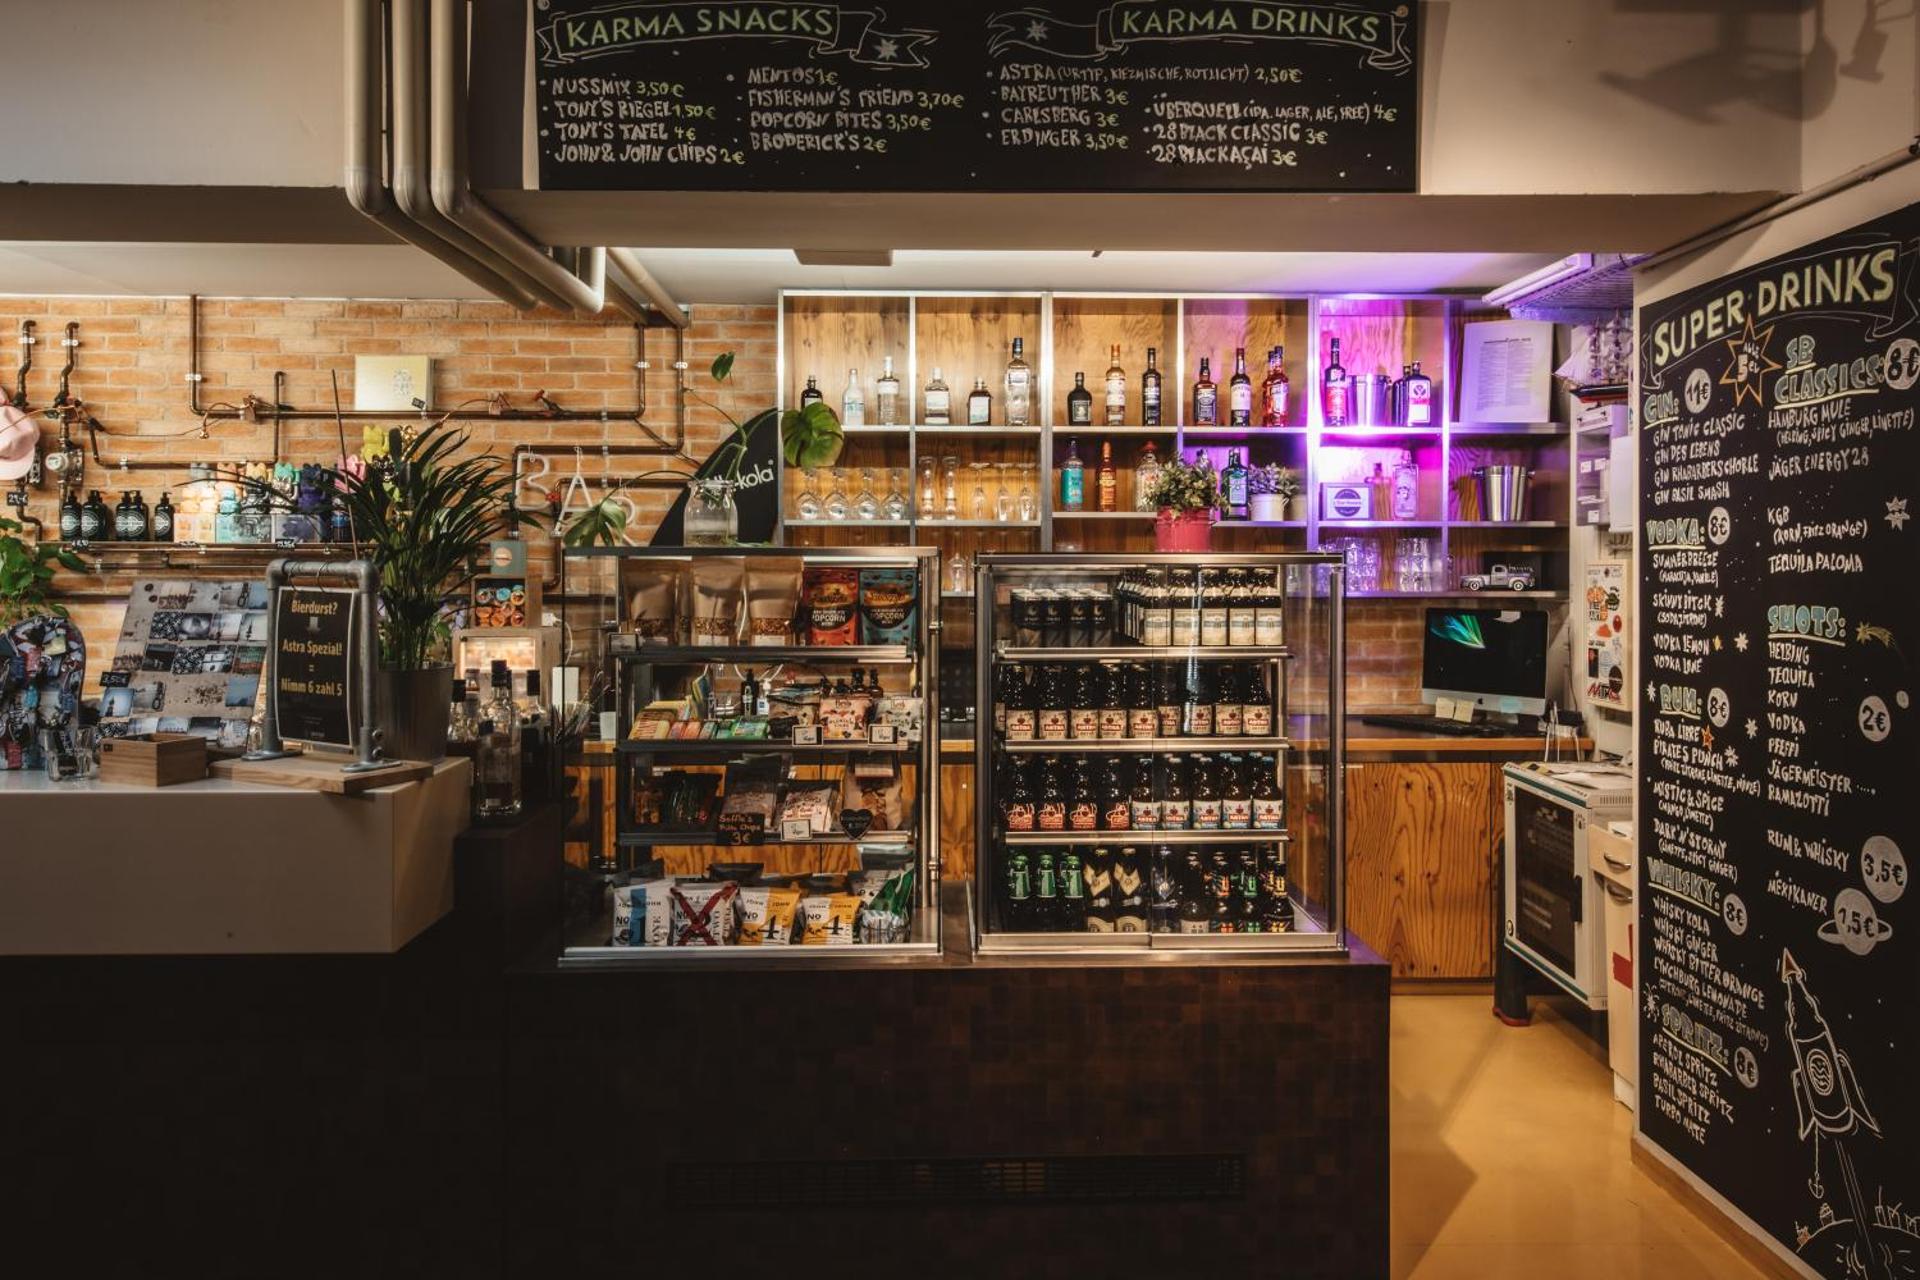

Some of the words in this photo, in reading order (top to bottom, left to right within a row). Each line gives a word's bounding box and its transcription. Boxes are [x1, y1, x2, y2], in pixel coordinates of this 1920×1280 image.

[567, 12, 685, 48] KARMA
[697, 7, 834, 36] SNACKS
[1122, 9, 1237, 34] KARMA
[1251, 9, 1380, 42] DRINKS
[748, 67, 815, 85] MENTOS
[1000, 64, 1056, 82] ASTRA
[1255, 67, 1303, 85] 2,50€
[749, 85, 850, 107] FISHERMAN'S
[859, 83, 914, 107] FRIEND
[917, 91, 965, 110] 3,70€
[1000, 83, 1101, 103] BAYREUTHER
[1104, 88, 1129, 105] 3€
[554, 97, 614, 119] TONY'S
[750, 110, 830, 129] POPCORN
[835, 108, 882, 130] BITES
[885, 113, 932, 132] 3,50€
[1001, 105, 1091, 125] CARLSBERG
[1094, 112, 1119, 128] 3€
[1373, 104, 1398, 122] 4€
[554, 121, 614, 142] TONY'S
[618, 123, 668, 140] TAFEL
[674, 125, 697, 141] 4€
[750, 131, 859, 151] BRODERICK'S
[863, 136, 887, 153] 2€
[1001, 128, 1081, 147] ERDINGER
[1084, 133, 1129, 151] 3,50€
[1152, 122, 1177, 140] 28
[1180, 122, 1227, 142] BLACK
[1231, 119, 1301, 142] CLASSIC
[1305, 128, 1329, 144] 3€
[619, 144, 664, 164] JOHN
[667, 141, 717, 164] CHIPS
[719, 148, 747, 165] 2€
[1151, 144, 1176, 163] 28
[1271, 150, 1298, 166] 3€
[1654, 290, 1745, 367] SUPER
[1758, 248, 1897, 318] DRINKS
[1786, 335, 1816, 370] SB
[1768, 406, 1818, 429] HAMBURG
[1821, 398, 1851, 422] MULE
[1653, 423, 1670, 447] GIN
[1672, 418, 1700, 441] TONIC
[1703, 408, 1745, 437] CLASSIC
[1654, 443, 1669, 466] GIN
[1670, 444, 1688, 462] DES
[1689, 439, 1720, 459] LEBENS
[1768, 454, 1802, 481] JÄGER
[1804, 448, 1849, 472] ENERGY
[1851, 446, 1870, 467] 28
[1654, 467, 1669, 487] GIN
[1654, 485, 1669, 506] GIN
[1698, 481, 1730, 501] SMASH
[1767, 505, 1790, 526] KGB
[1645, 517, 1706, 545] VODKA:
[1710, 516, 1728, 537] 8€
[1768, 548, 1814, 574] TEQUILA
[1815, 552, 1864, 574] PALOMA
[290, 599, 338, 616] Bierdurst?
[1767, 604, 1847, 638] SHOTS:
[281, 638, 306, 653] Astra
[306, 640, 343, 657] Spezial!
[1653, 633, 1681, 652] VODKA
[1682, 634, 1710, 656] LEMON
[1768, 639, 1809, 665] HELBING
[1653, 654, 1681, 672] VODKA
[280, 677, 307, 694] Nimm
[307, 681, 315, 694] 6
[315, 682, 336, 697] zahl
[336, 683, 343, 697] 5
[1768, 665, 1815, 688] TEQUILA
[1710, 695, 1727, 718] 8€
[1767, 689, 1798, 709] KORN
[1677, 718, 1701, 742] LIBRE
[1767, 712, 1807, 735] VODKA
[1861, 704, 1887, 732] 2€
[1653, 736, 1689, 763] PIRATES
[1691, 747, 1723, 771] PUNCH
[1767, 759, 1852, 794] JÄGERMEISTER
[1768, 783, 1831, 817] RAMAZOTTI
[1803, 837, 1850, 873] WHISKY
[1863, 852, 1905, 887] 3,5€
[1646, 856, 1720, 910] WHISKY:
[1767, 876, 1828, 917] MEXIKANER
[616, 915, 630, 925] NO
[757, 915, 780, 940] 4
[807, 913, 822, 921] NO
[821, 915, 844, 936] 4
[1652, 895, 1686, 924] WHISKY
[1686, 910, 1710, 938] KOLA
[1837, 907, 1876, 938] 1,5€
[1653, 916, 1685, 946] WHISKY
[1685, 930, 1719, 964] GINGER
[1654, 936, 1687, 966] WHISKY
[1688, 953, 1721, 986] BITTER
[1721, 970, 1766, 1010] ORANGE
[1701, 982, 1748, 1019] LEMONADE
[1660, 1003, 1730, 1065] SPRITZ:
[1652, 1033, 1684, 1067] APEROL
[1684, 1053, 1718, 1087] SPRITZ
[1676, 1087, 1711, 1126] SPRITZ
[1699, 1077, 1735, 1125] SPRITZ
[1654, 1093, 1682, 1124] TURBO
[1682, 1115, 1706, 1146] MATE
